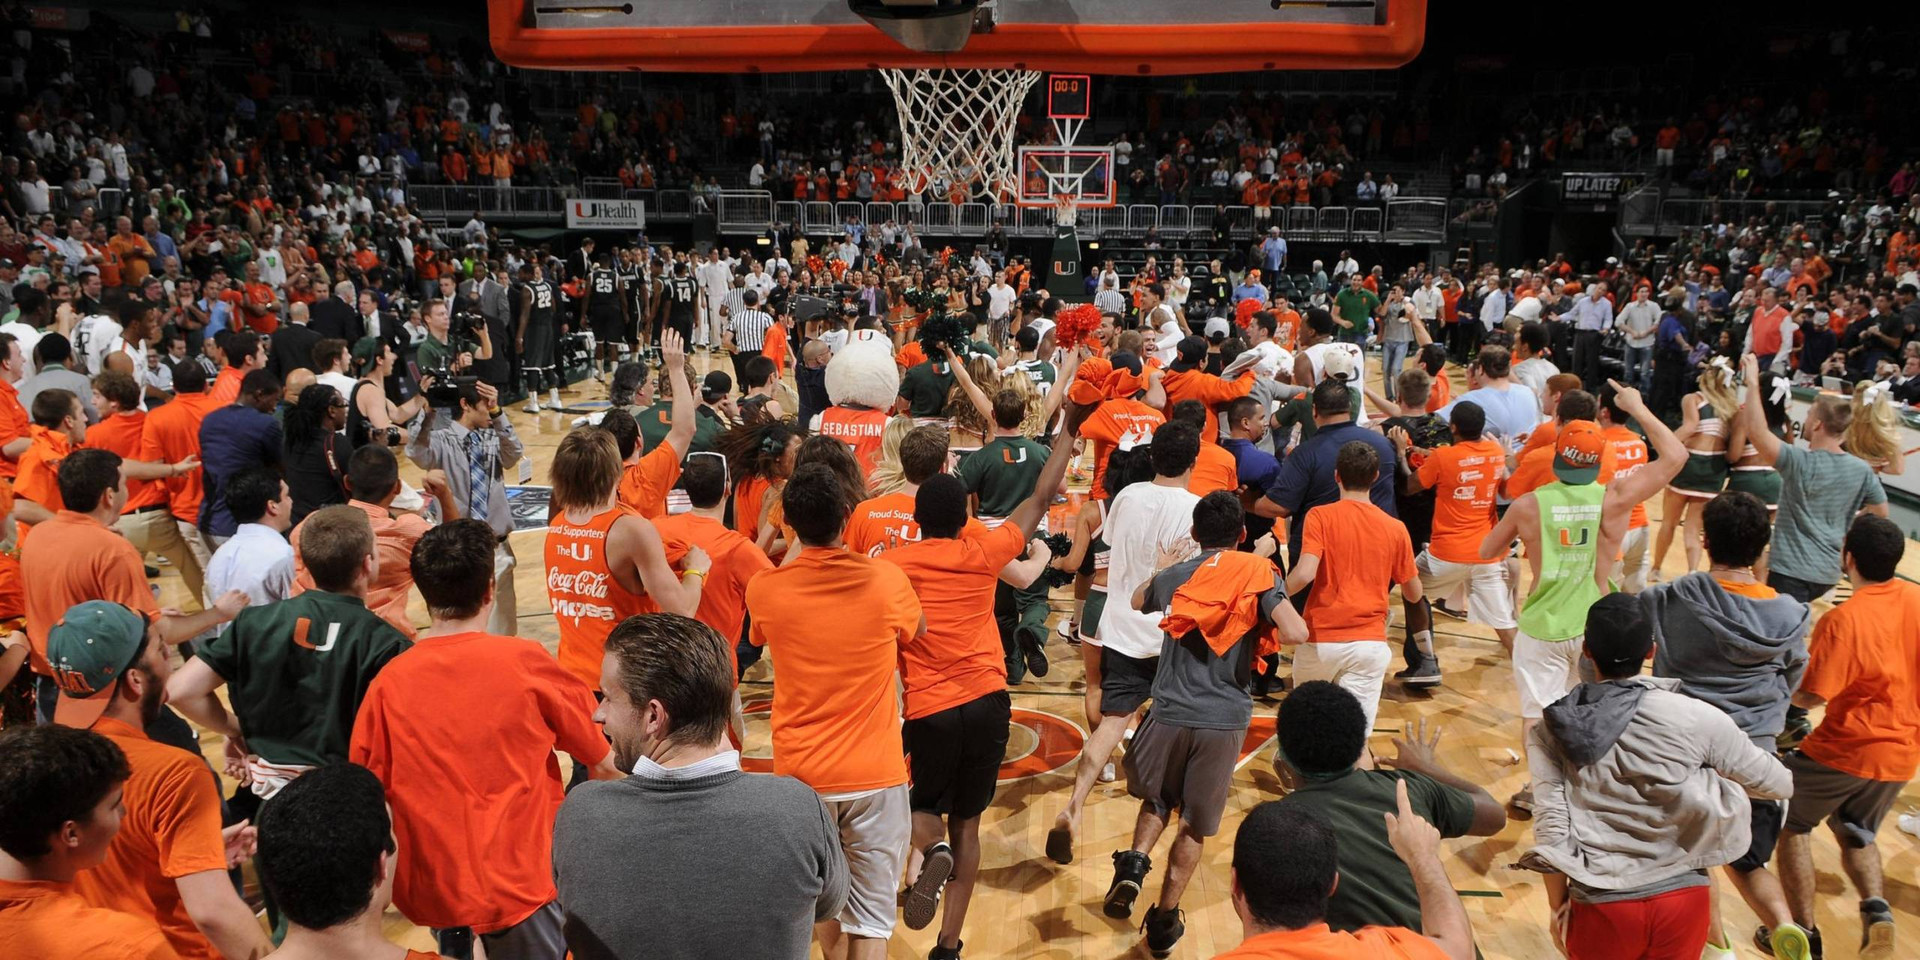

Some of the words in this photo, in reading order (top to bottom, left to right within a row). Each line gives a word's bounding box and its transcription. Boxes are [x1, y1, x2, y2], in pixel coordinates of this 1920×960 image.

[1566, 178, 1583, 191] UP
[1583, 178, 1620, 191] LATE?
[1054, 261, 1076, 275] U
[596, 278, 612, 293] 25
[538, 290, 552, 308] 22
[677, 287, 692, 302] 14
[822, 423, 882, 437] SEBASTIAN
[1002, 447, 1027, 463] U
[1562, 445, 1599, 464] MIAMI
[868, 510, 891, 519] Proud
[563, 526, 604, 539] Supporters
[885, 527, 900, 536] The
[1560, 528, 1588, 547] U
[556, 544, 571, 557] The
[293, 617, 341, 651] U
